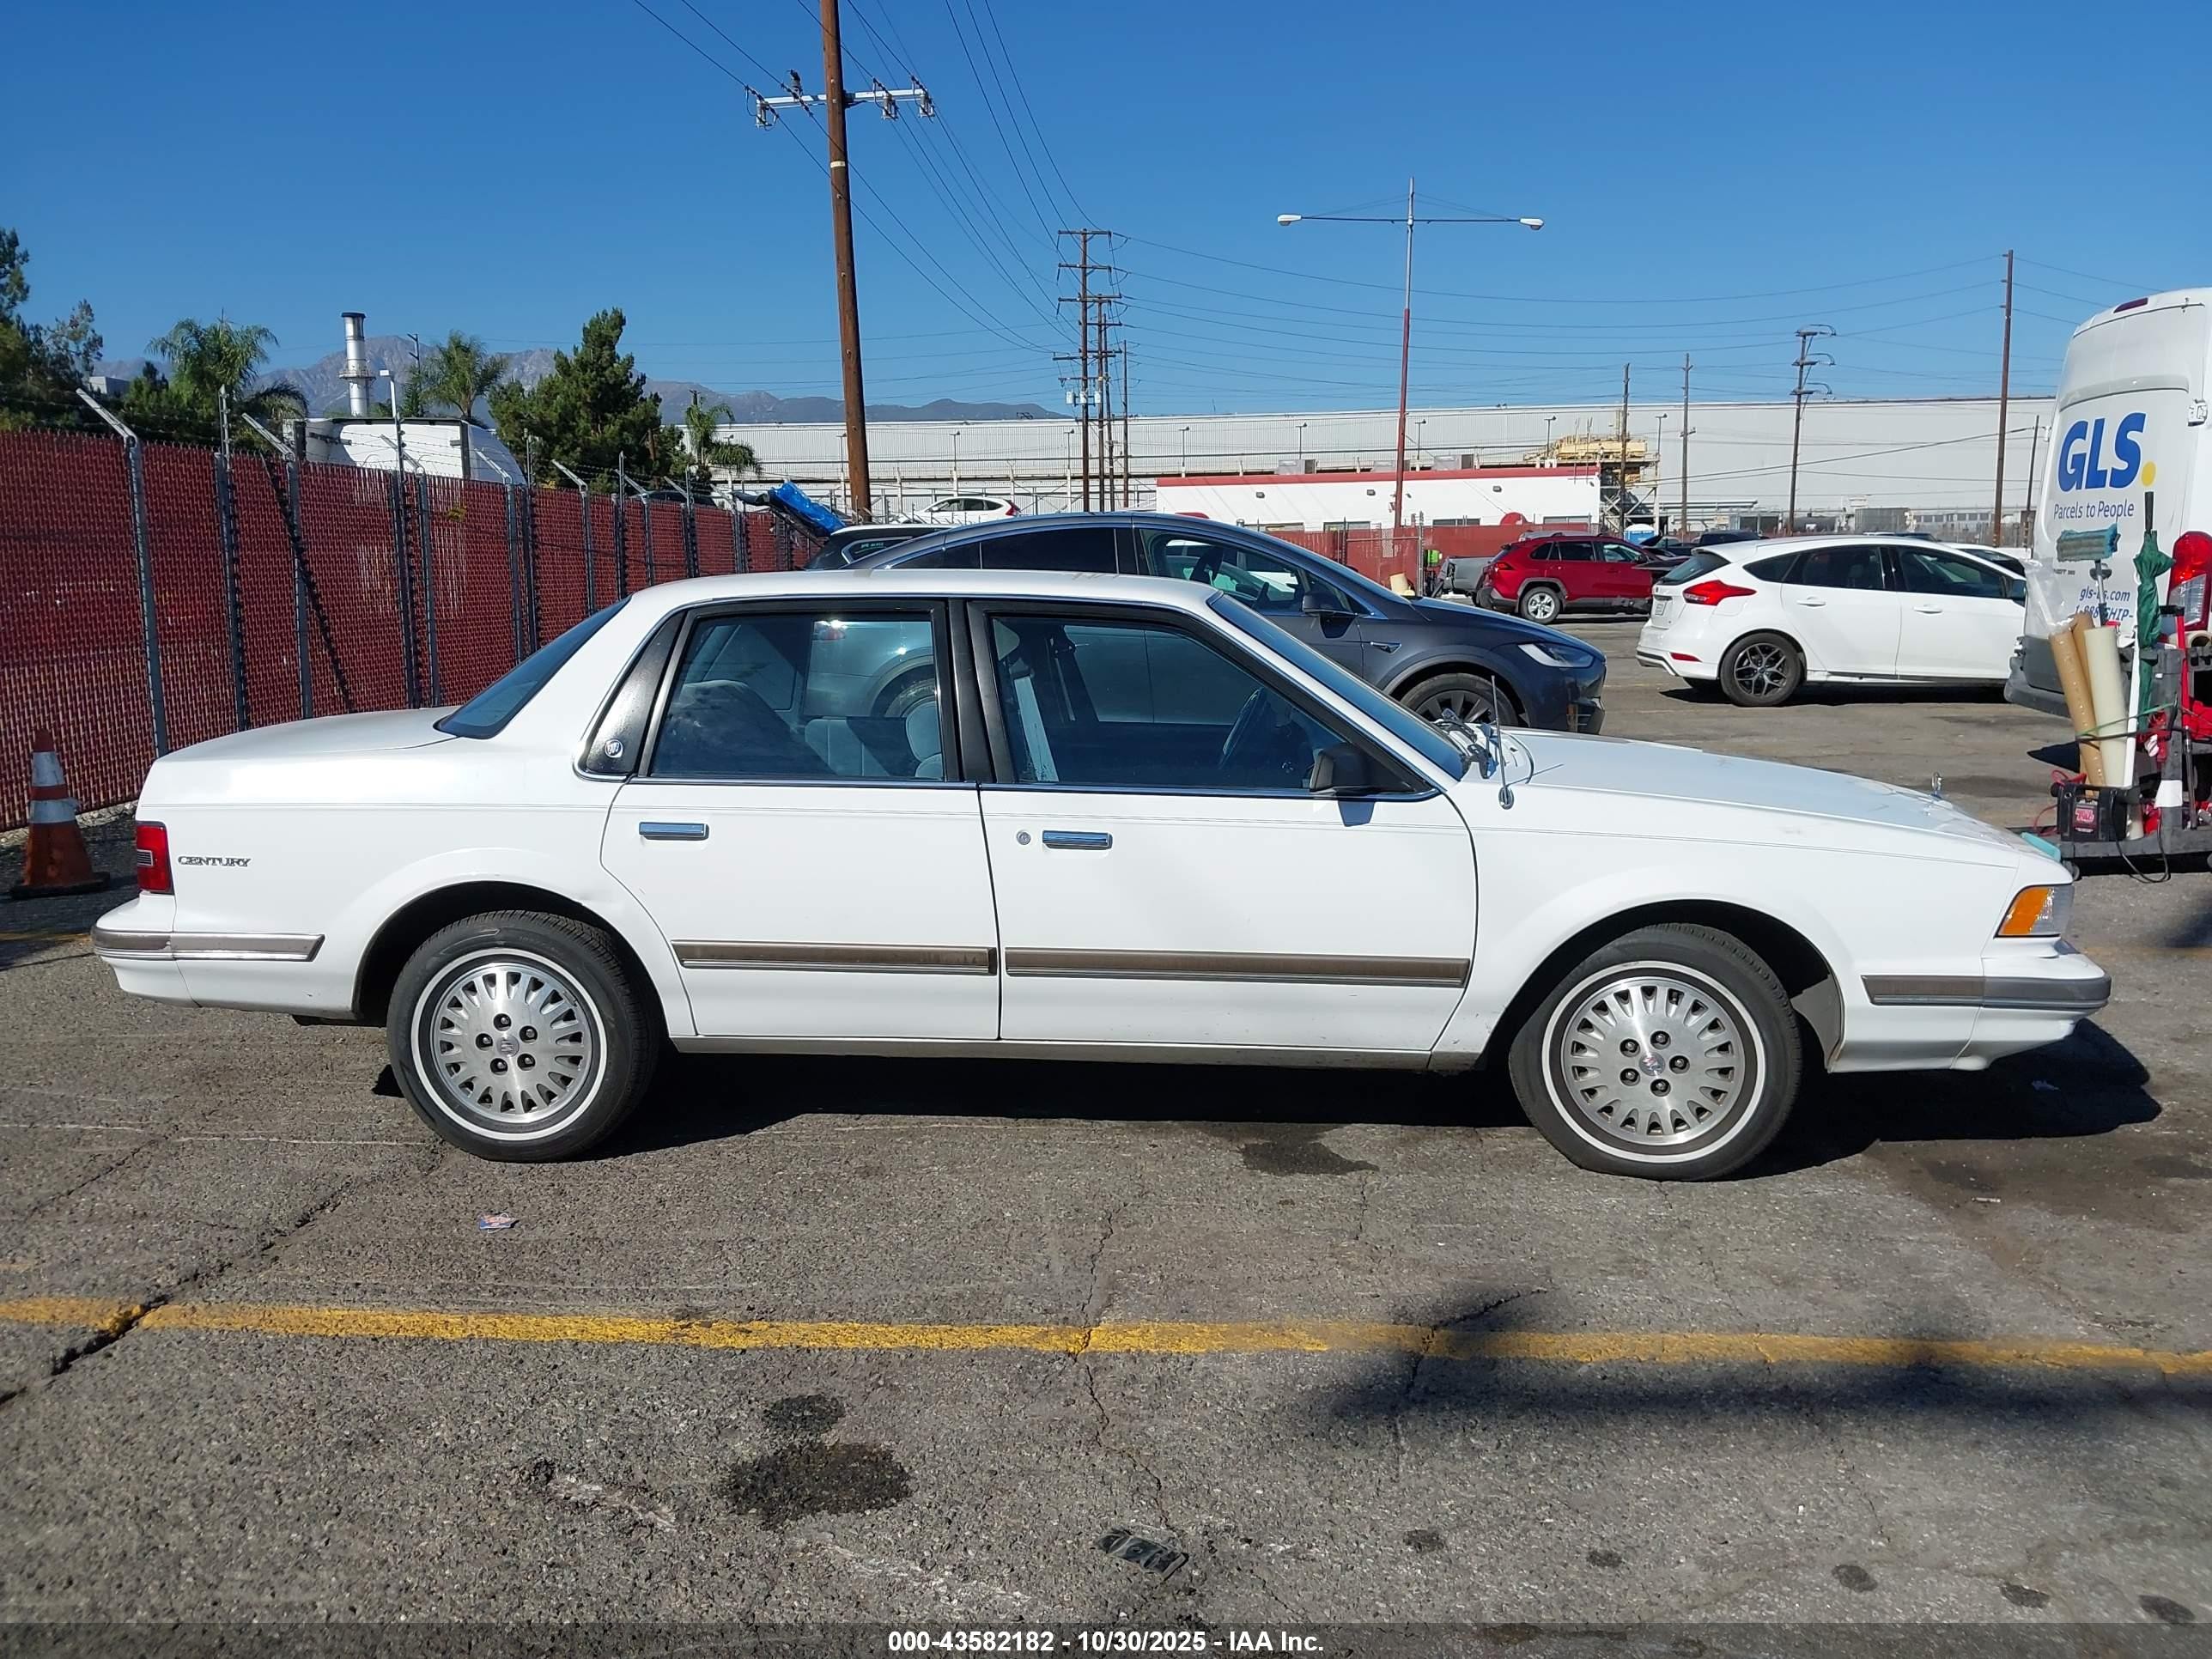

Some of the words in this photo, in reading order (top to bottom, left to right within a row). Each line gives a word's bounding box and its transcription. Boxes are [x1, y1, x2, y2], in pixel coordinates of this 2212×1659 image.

[2053, 501, 2083, 520] Parcels
[2086, 502, 2095, 518] to
[2097, 498, 2135, 522] People
[177, 855, 252, 867] CENTURY
